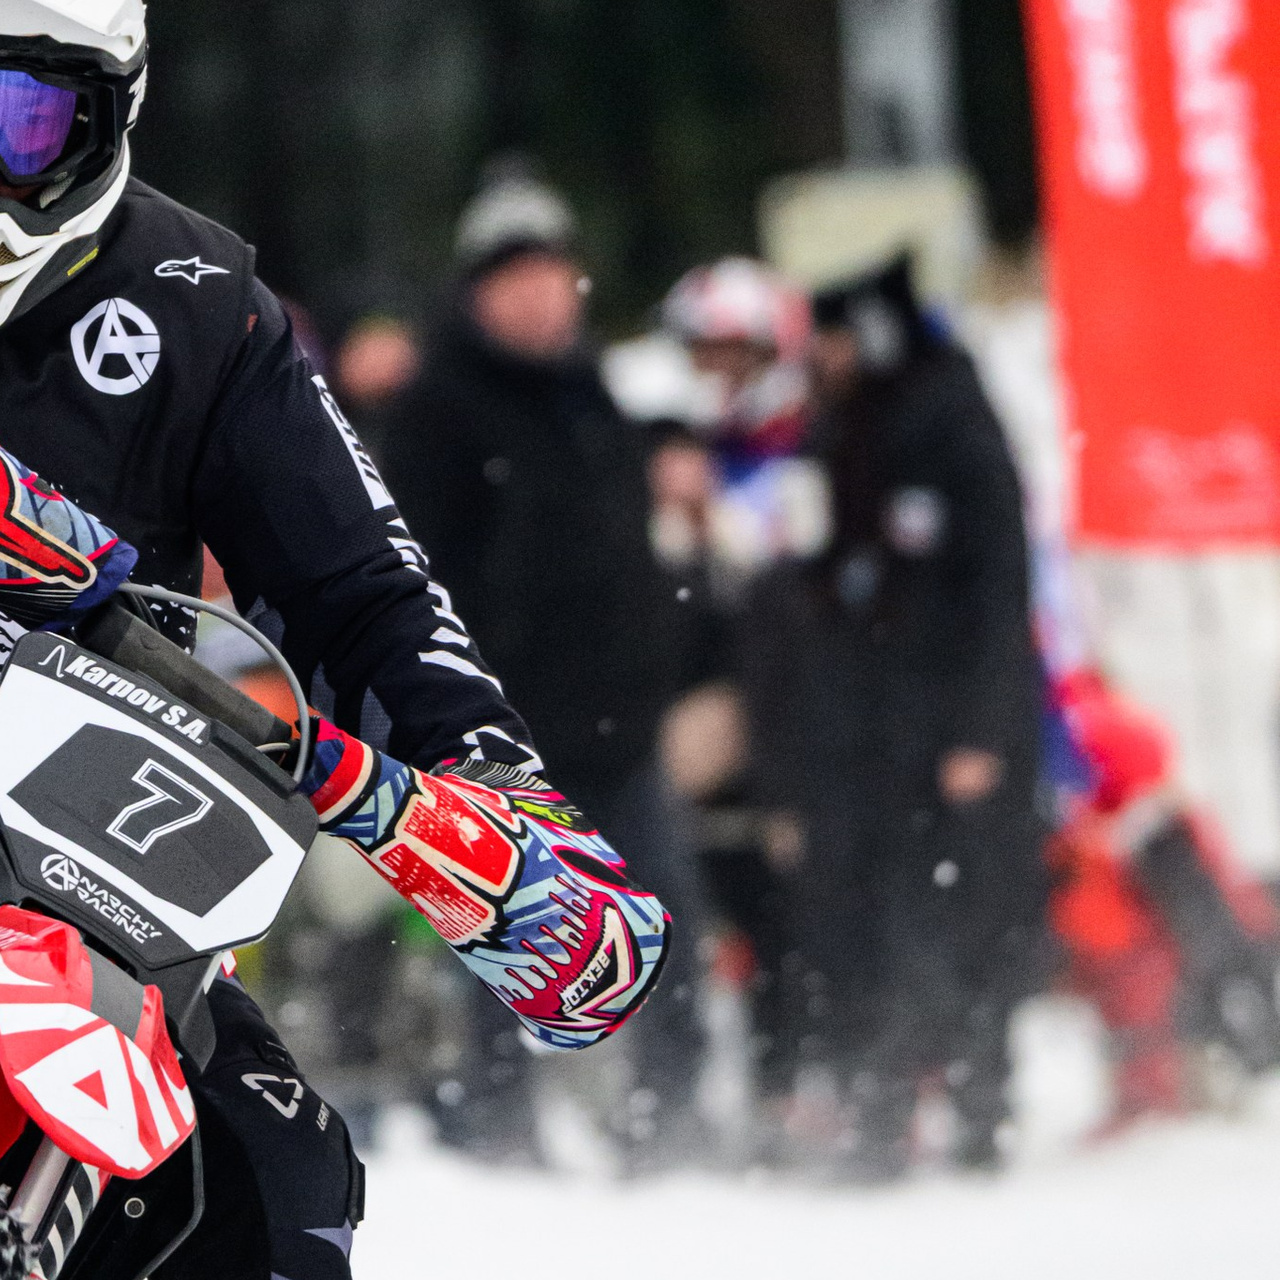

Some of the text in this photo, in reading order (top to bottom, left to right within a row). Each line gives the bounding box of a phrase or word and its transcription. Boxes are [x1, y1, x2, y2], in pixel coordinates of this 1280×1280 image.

[64, 655, 207, 745] Karpov S.A.
[105, 758, 214, 855] 7
[76, 886, 149, 944] RACING
[560, 950, 610, 1014] ВЕКТОР
